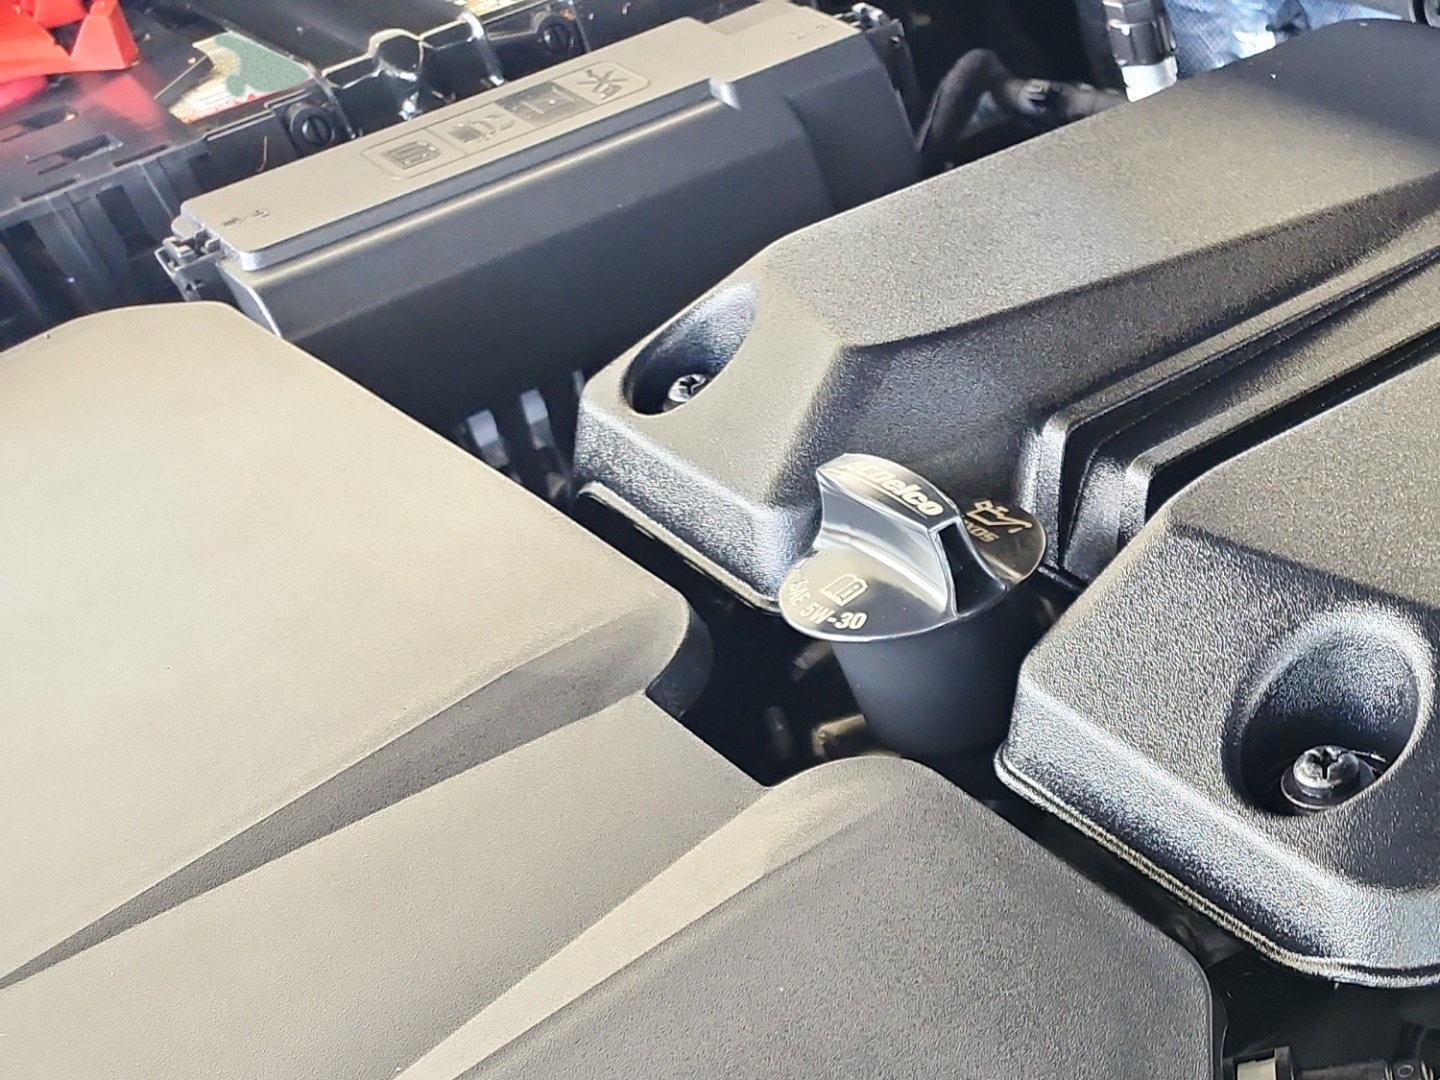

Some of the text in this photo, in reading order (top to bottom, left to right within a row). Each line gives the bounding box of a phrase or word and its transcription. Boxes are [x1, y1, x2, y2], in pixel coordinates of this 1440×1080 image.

[838, 461, 944, 516] ACDelco
[788, 577, 867, 630] SAE 5W-30
